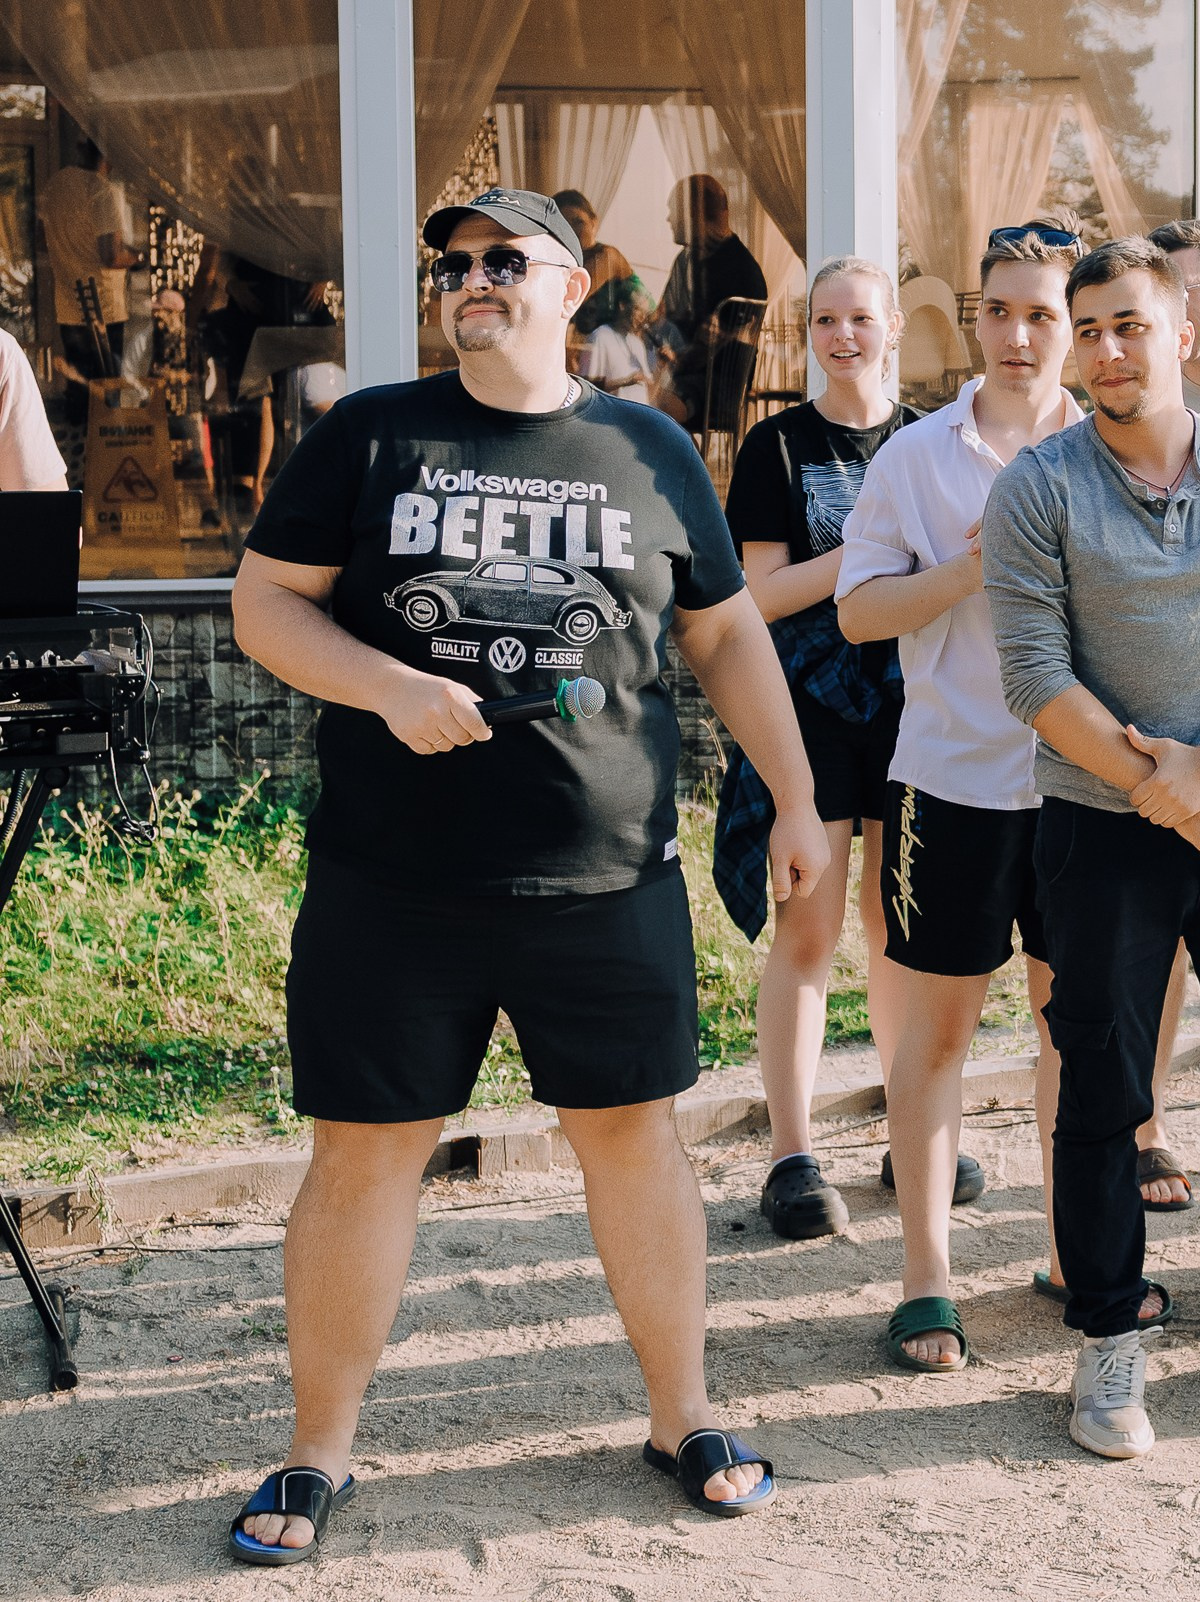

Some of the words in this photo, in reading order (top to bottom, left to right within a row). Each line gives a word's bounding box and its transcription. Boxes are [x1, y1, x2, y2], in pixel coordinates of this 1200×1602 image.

[420, 466, 607, 503] Volkswagen
[388, 492, 635, 570] BEETLE
[431, 641, 480, 658] QUALITY
[535, 651, 584, 666] CLASSIC
